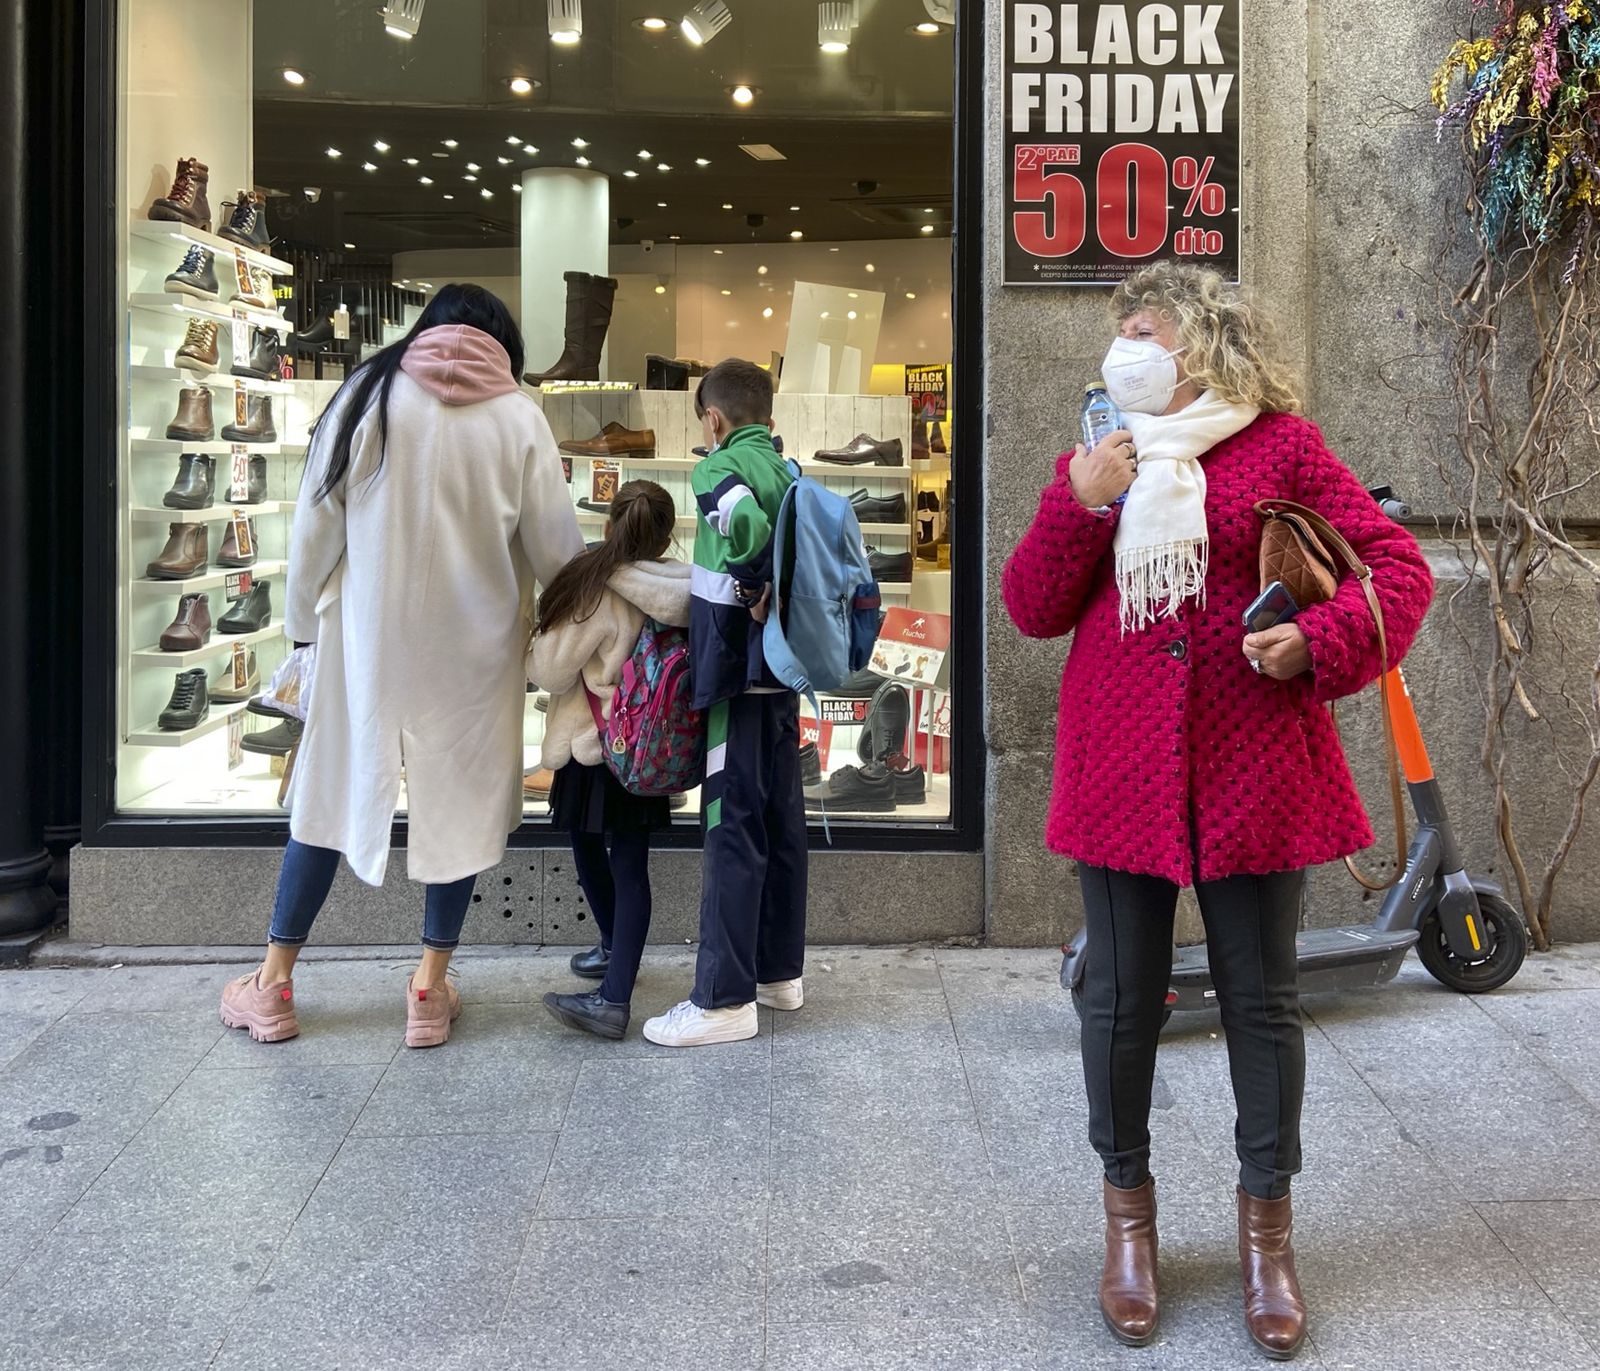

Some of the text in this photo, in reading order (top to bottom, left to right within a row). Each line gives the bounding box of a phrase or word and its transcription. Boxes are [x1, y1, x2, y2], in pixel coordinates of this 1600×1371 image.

[1013, 3, 1225, 65] BLACK
[1011, 73, 1235, 133] FRIDAY
[1013, 142, 1226, 258] 50%
[1174, 226, 1224, 255] dto
[1062, 271, 1087, 279] SELECCIÓN
[908, 372, 943, 382] BLACK
[908, 382, 945, 392] FRIDAY
[598, 478, 613, 497] PIEL
[902, 628, 926, 640] Fluchos
[823, 701, 853, 711] BLACK
[823, 711, 854, 721] FRIDAY
